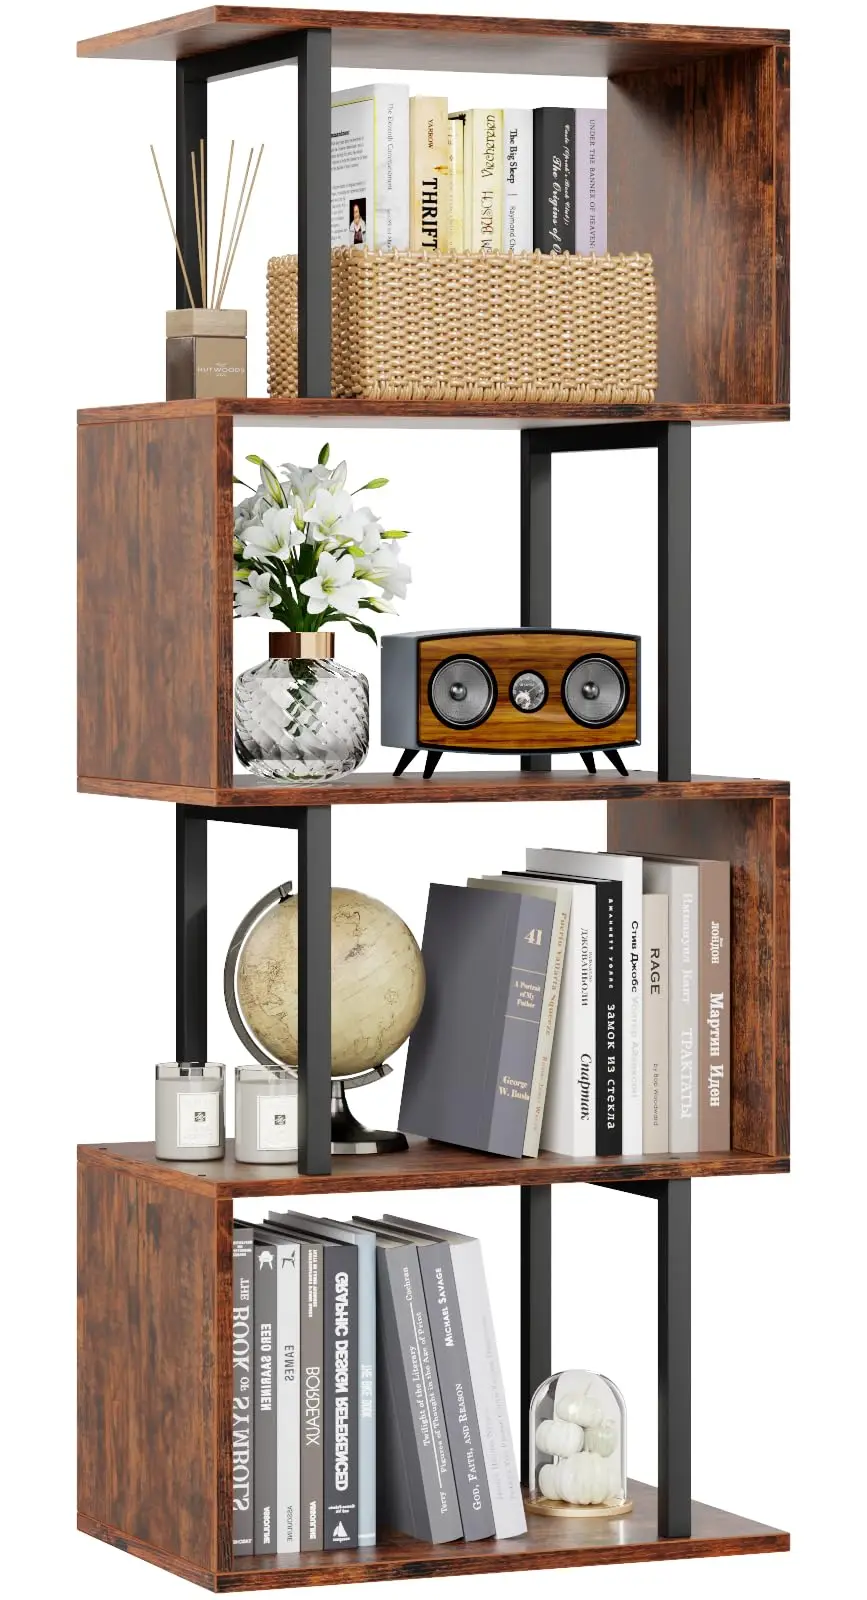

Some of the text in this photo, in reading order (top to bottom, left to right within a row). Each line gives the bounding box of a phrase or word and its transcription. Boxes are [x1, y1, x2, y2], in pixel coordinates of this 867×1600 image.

[507, 146, 518, 160] Big
[552, 156, 562, 178] The
[507, 162, 518, 184] Sleep
[422, 178, 438, 250] THRIFT
[481, 191, 494, 234] BUSCH
[548, 182, 562, 226] Origins
[589, 201, 595, 212] OF
[508, 206, 516, 238] Raymond
[548, 226, 562, 242] of
[524, 928, 543, 946] 41
[580, 928, 589, 1006] ДЖОВАНЬОЛИ
[630, 921, 640, 993] Стив Джобс
[650, 948, 660, 995] RAGE
[707, 992, 724, 1107] Мартин Иден
[503, 1076, 528, 1090] George
[653, 1063, 659, 1072] by
[680, 1028, 692, 1119] ТРАКТАТЫ
[499, 1086, 530, 1101] W. Bush
[577, 1053, 592, 1121] Спартак
[403, 1267, 413, 1301] Cochran
[416, 1312, 424, 1335] Print
[435, 1267, 455, 1347] MICHAEL SAVAGE
[419, 1336, 426, 1345] of
[409, 1344, 420, 1382] Literary
[428, 1382, 434, 1391] in
[417, 1399, 424, 1408] of
[429, 1393, 439, 1429] Thought
[419, 1410, 430, 1447] Twilight
[434, 1429, 441, 1439] of
[438, 1440, 447, 1473] Figures
[455, 1383, 482, 1511] GOD, FAITH, AND REASON
